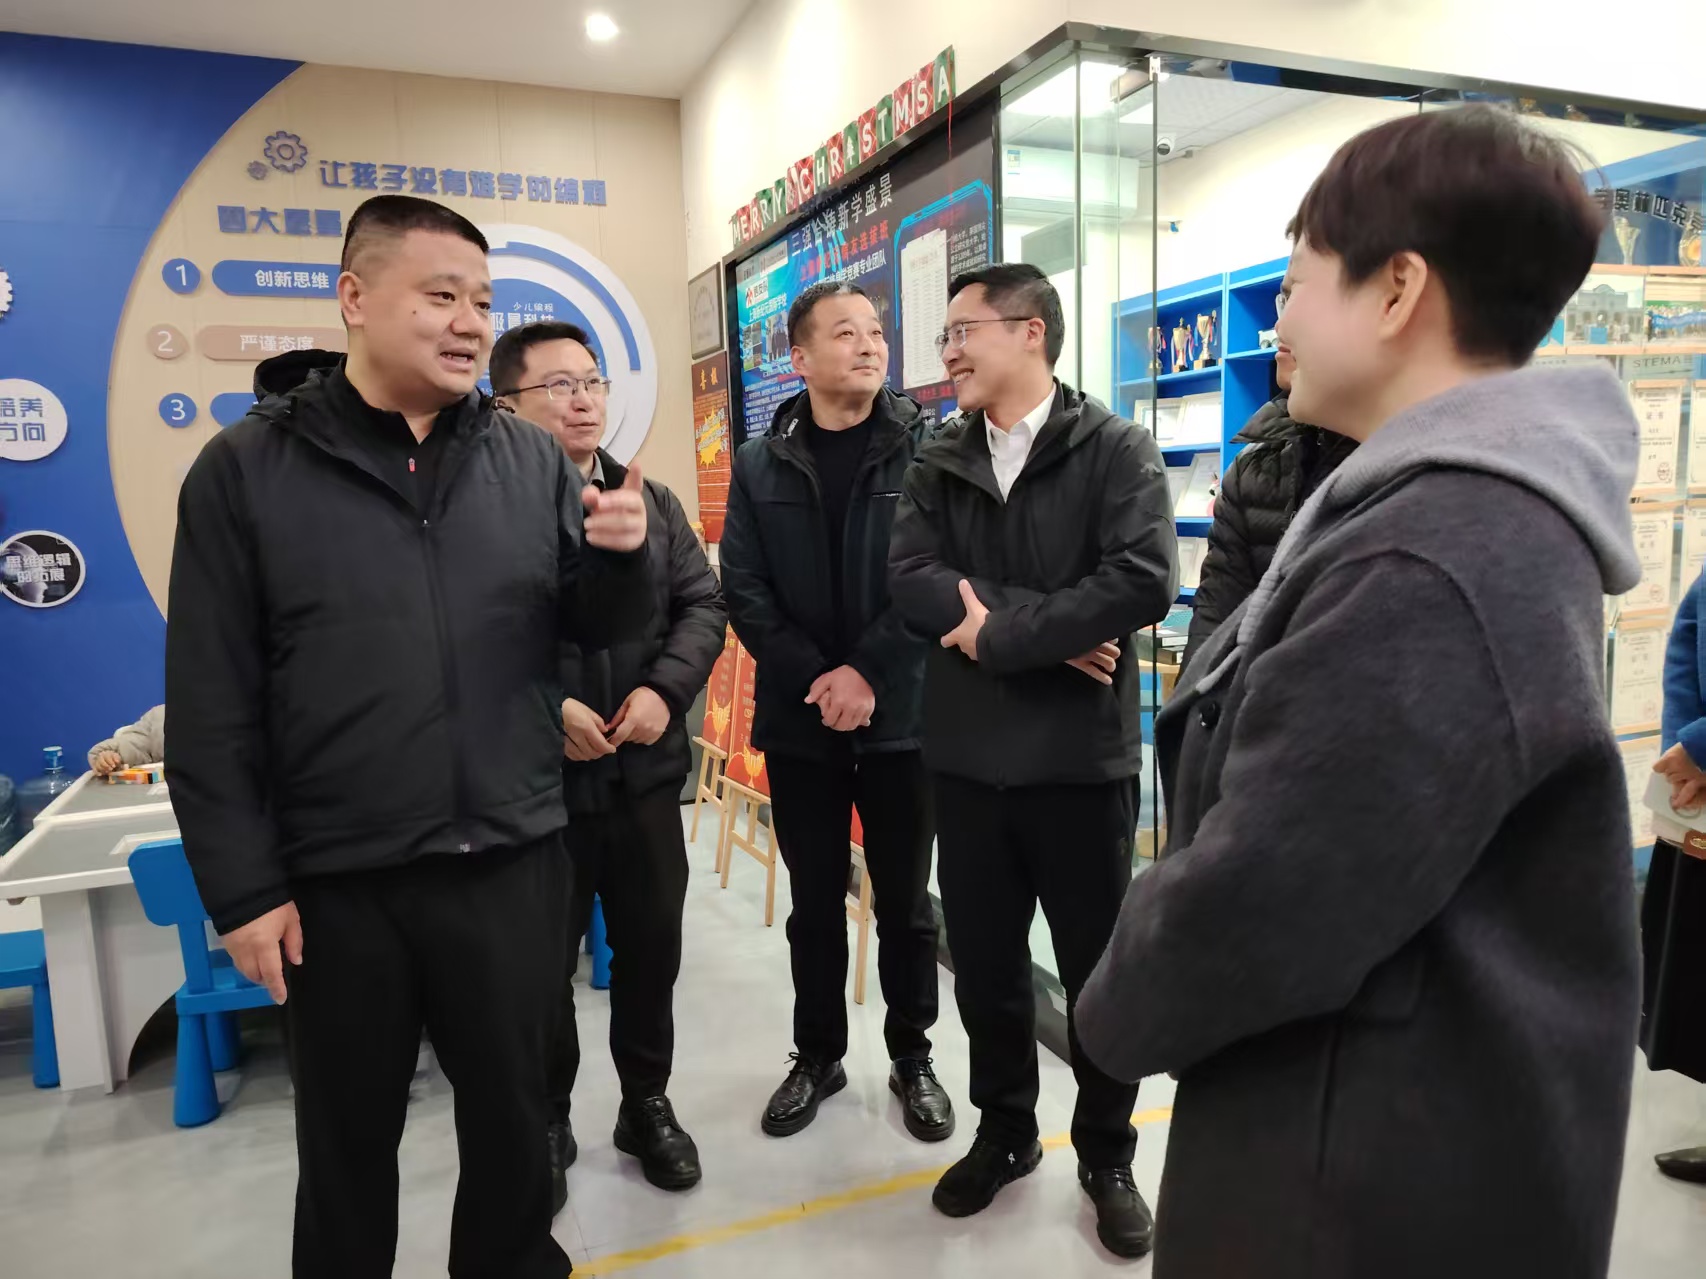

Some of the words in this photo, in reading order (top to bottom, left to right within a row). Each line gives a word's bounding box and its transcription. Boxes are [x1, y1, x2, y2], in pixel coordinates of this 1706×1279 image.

[175, 264, 187, 287] 1
[255, 269, 330, 289] 创新思维
[513, 302, 554, 313] 少儿编程
[157, 331, 174, 353] 2
[240, 334, 315, 352] 严谨态度
[1633, 355, 1681, 369] STEMA
[169, 399, 186, 421] 3
